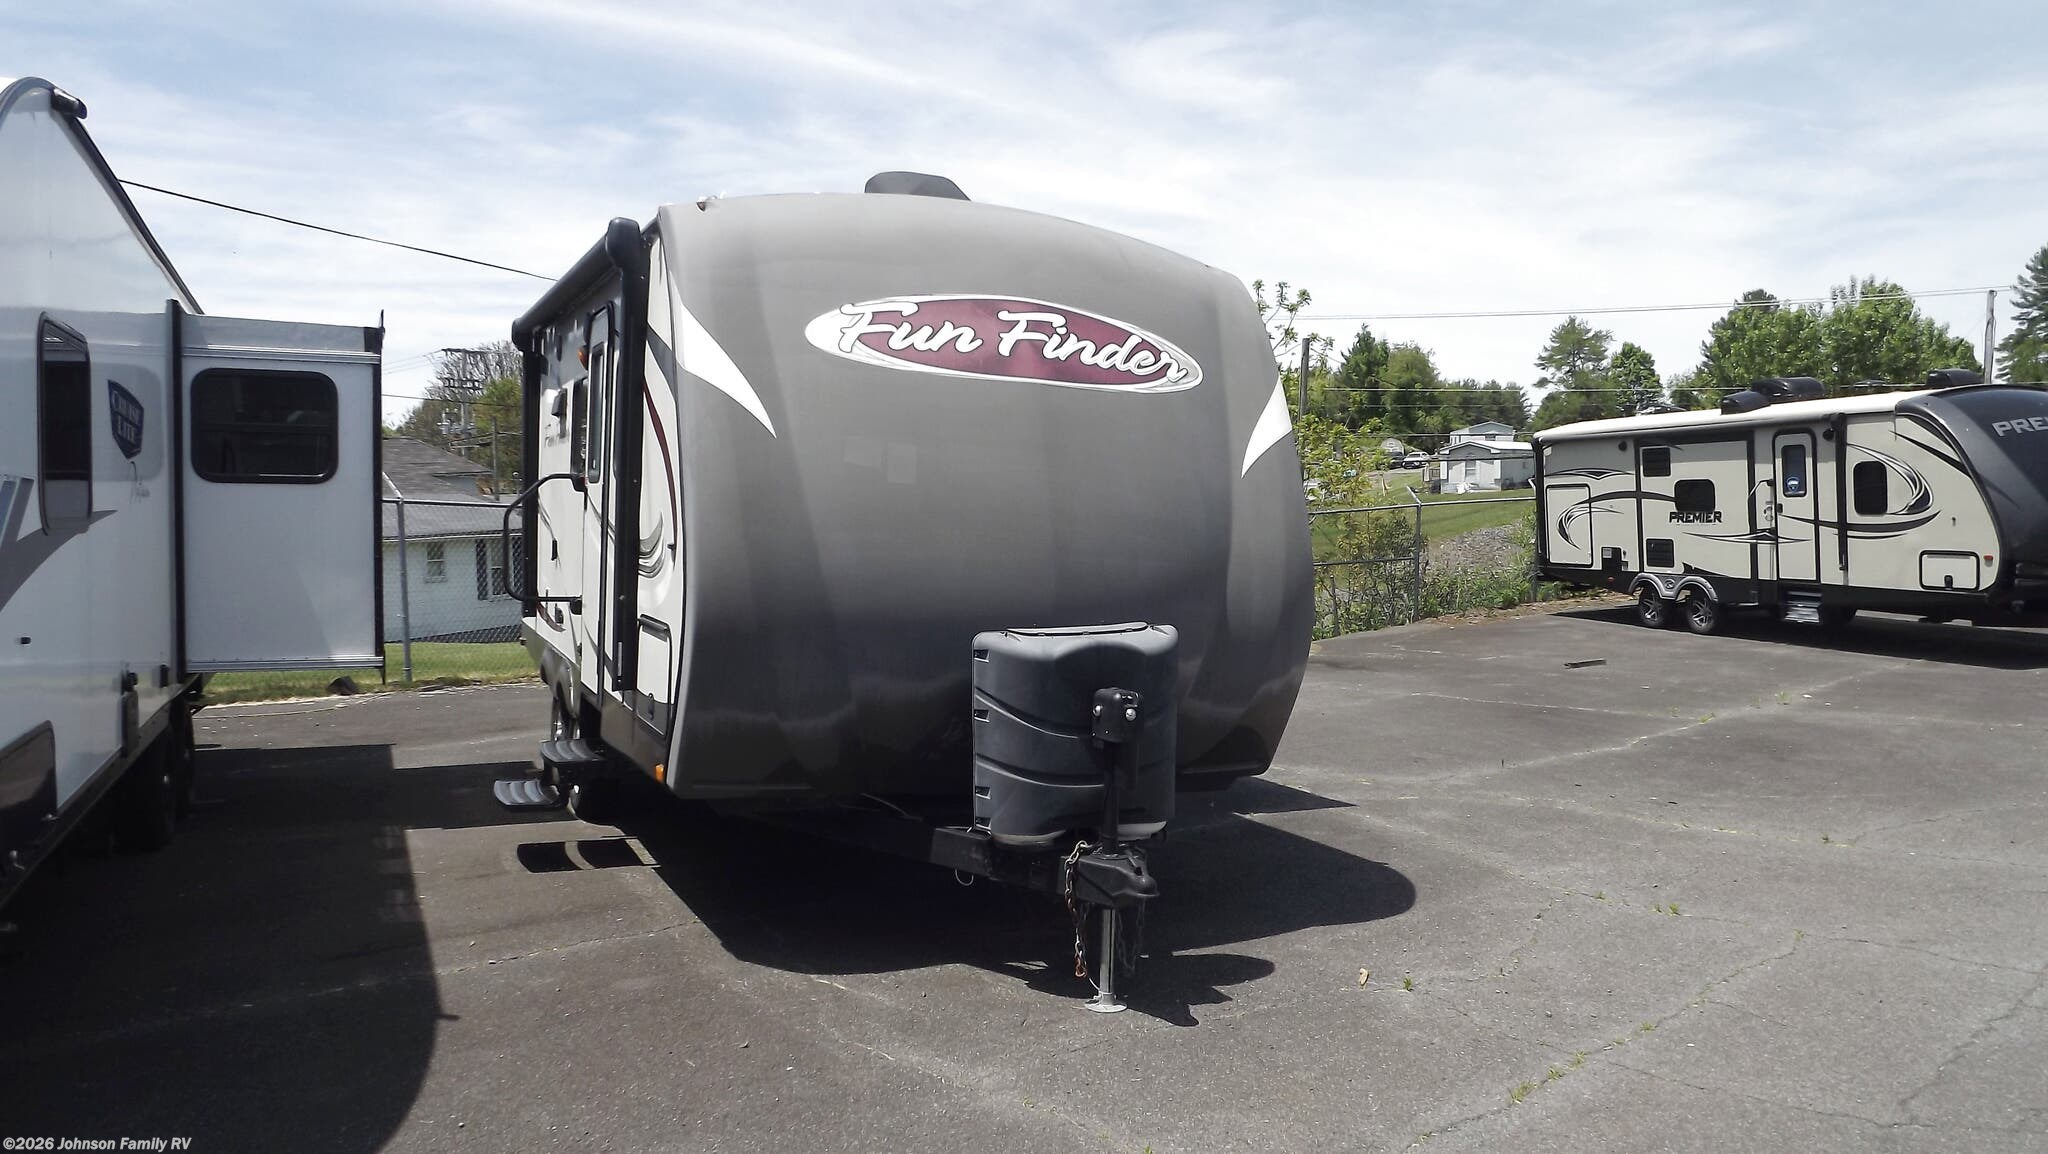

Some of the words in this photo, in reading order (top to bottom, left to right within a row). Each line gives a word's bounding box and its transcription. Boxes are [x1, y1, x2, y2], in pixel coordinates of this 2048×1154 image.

[839, 302, 983, 353] Fun
[997, 310, 1188, 381] Finder
[1992, 416, 2048, 437] PRE
[1669, 511, 1722, 523] PREMIER
